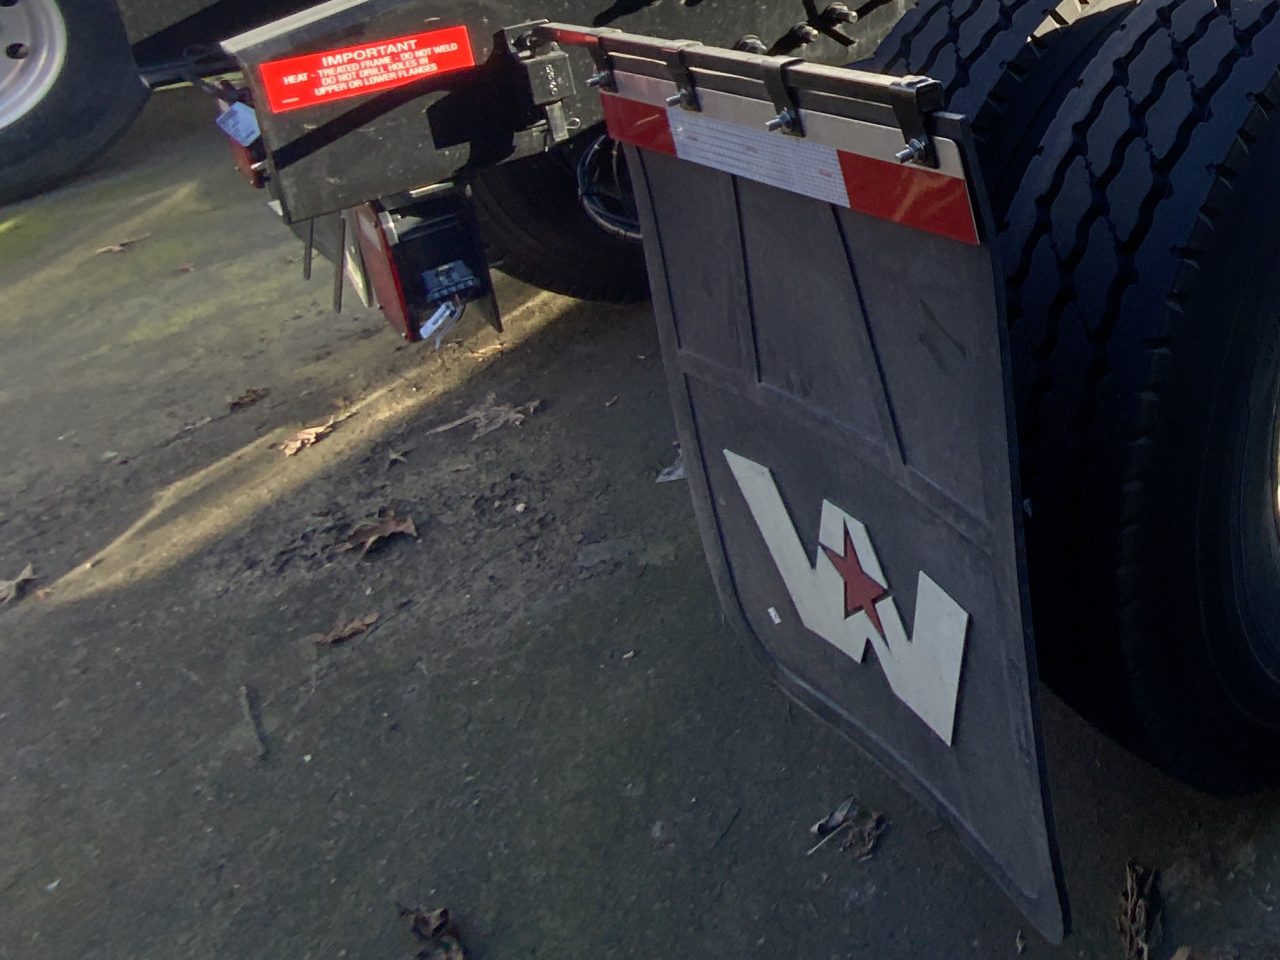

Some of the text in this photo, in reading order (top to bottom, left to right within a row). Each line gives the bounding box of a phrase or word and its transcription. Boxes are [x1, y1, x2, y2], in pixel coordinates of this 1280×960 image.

[283, 72, 308, 85] HEAT
[317, 63, 359, 77] TREATED
[360, 56, 392, 69] FRAME
[400, 51, 413, 61] DO
[414, 47, 431, 57] NOT
[432, 42, 458, 54] WELD
[322, 40, 417, 67] IMPORTANT
[314, 62, 438, 96] UPPER OR LOWER FLANGES
[321, 56, 429, 86] DO NOT DRILL HOLES IN
